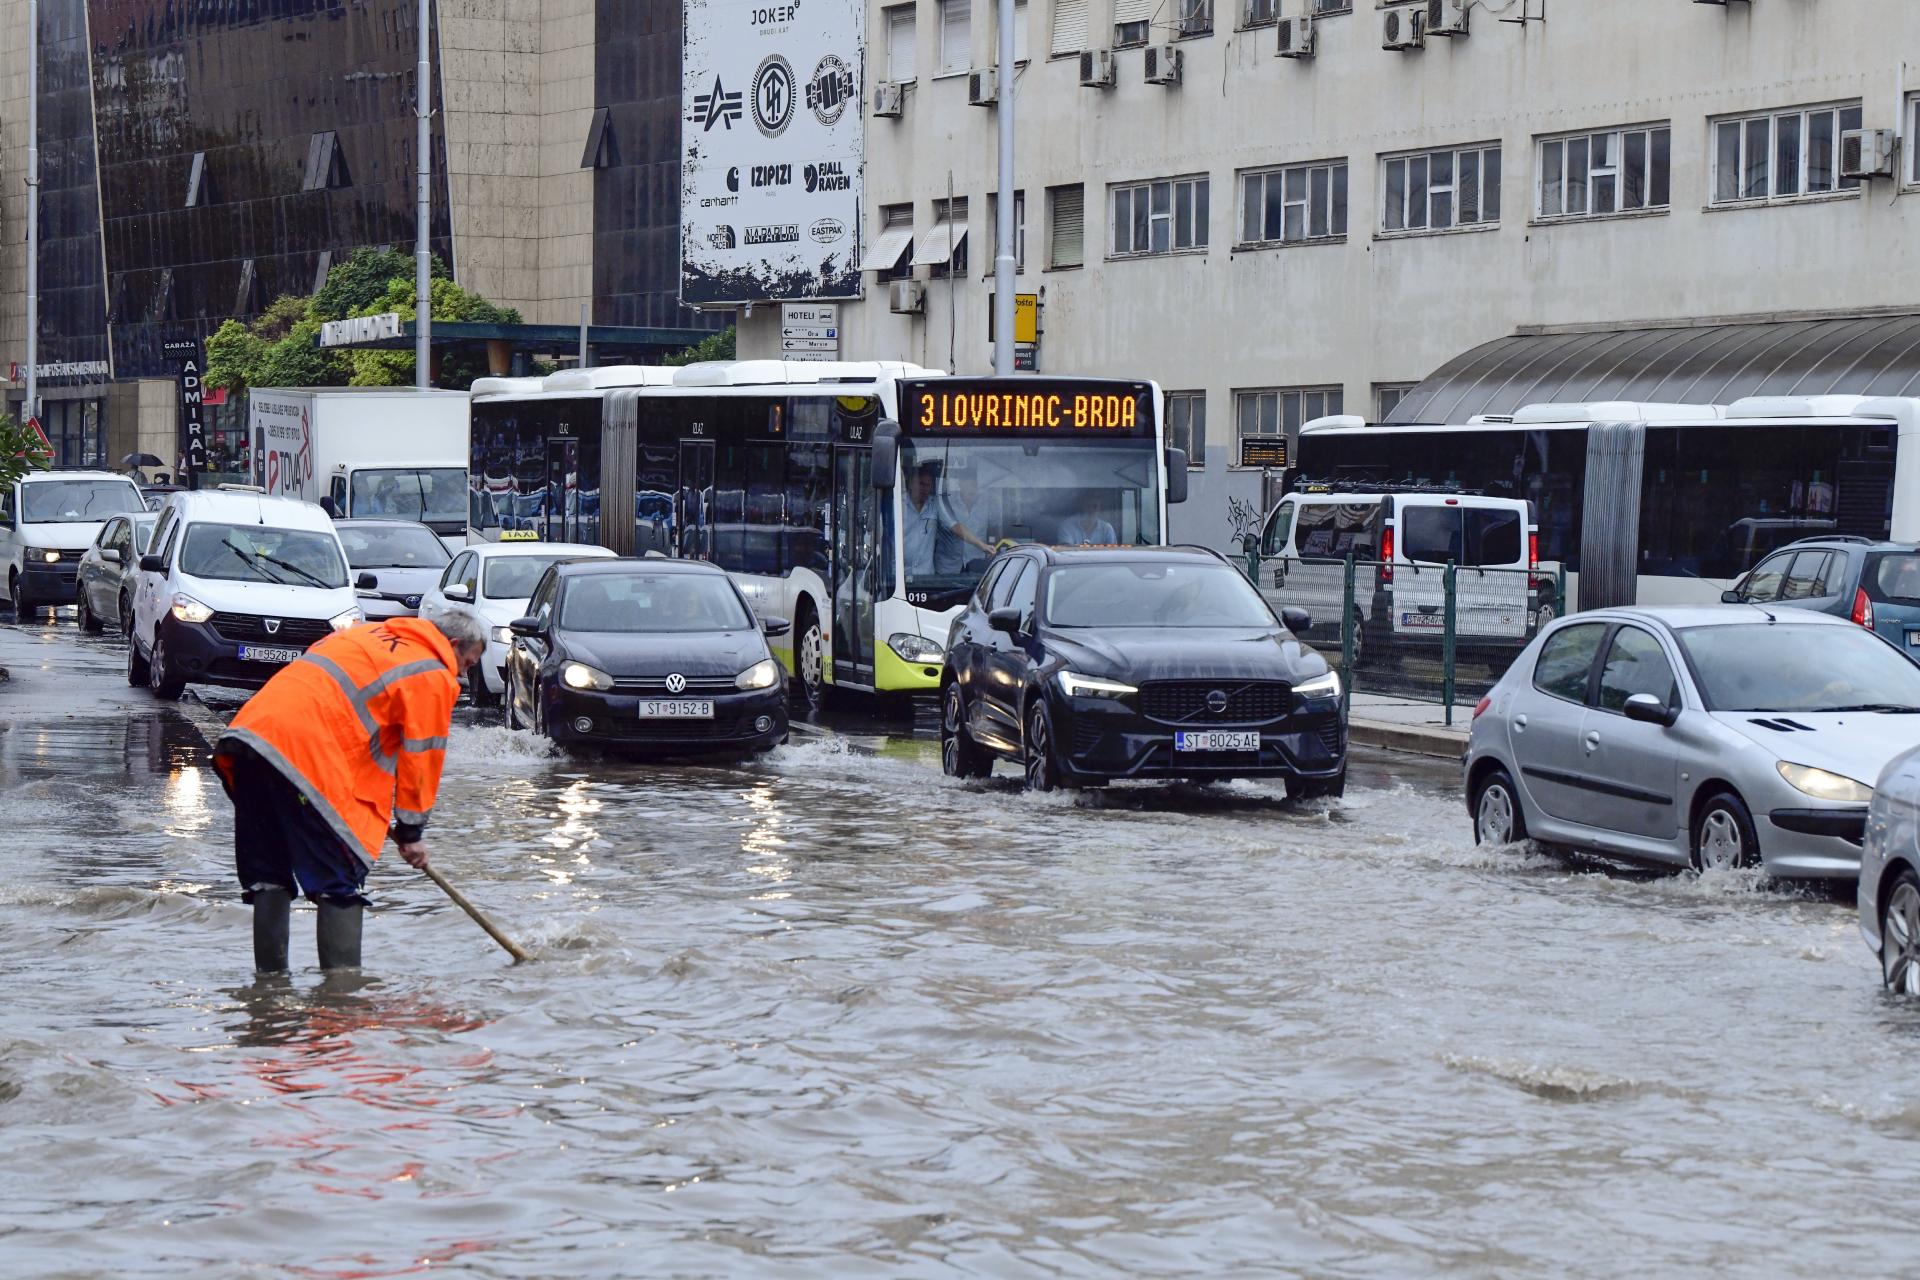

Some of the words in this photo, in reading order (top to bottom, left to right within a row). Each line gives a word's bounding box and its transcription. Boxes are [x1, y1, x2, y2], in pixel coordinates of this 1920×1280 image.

[751, 6, 795, 25] JOKER
[751, 163, 792, 187] IZIPIZI
[700, 196, 739, 208] carhartt
[715, 225, 727, 233] THE
[811, 226, 842, 236] EASTPAK
[706, 233, 727, 242] NORTH
[712, 241, 727, 250] FACE
[788, 311, 815, 320] HOTELI
[164, 340, 196, 349] GARAŽA
[183, 360, 204, 467] ADMIRAL
[921, 394, 934, 426] 3
[942, 394, 1136, 428] LOVRINAC-BRDA
[849, 426, 862, 440] ULAZ
[908, 592, 927, 603] 019
[245, 648, 257, 659] ST
[648, 702, 661, 715] ST
[669, 702, 709, 715] 9152-B
[1185, 734, 1200, 748] ST
